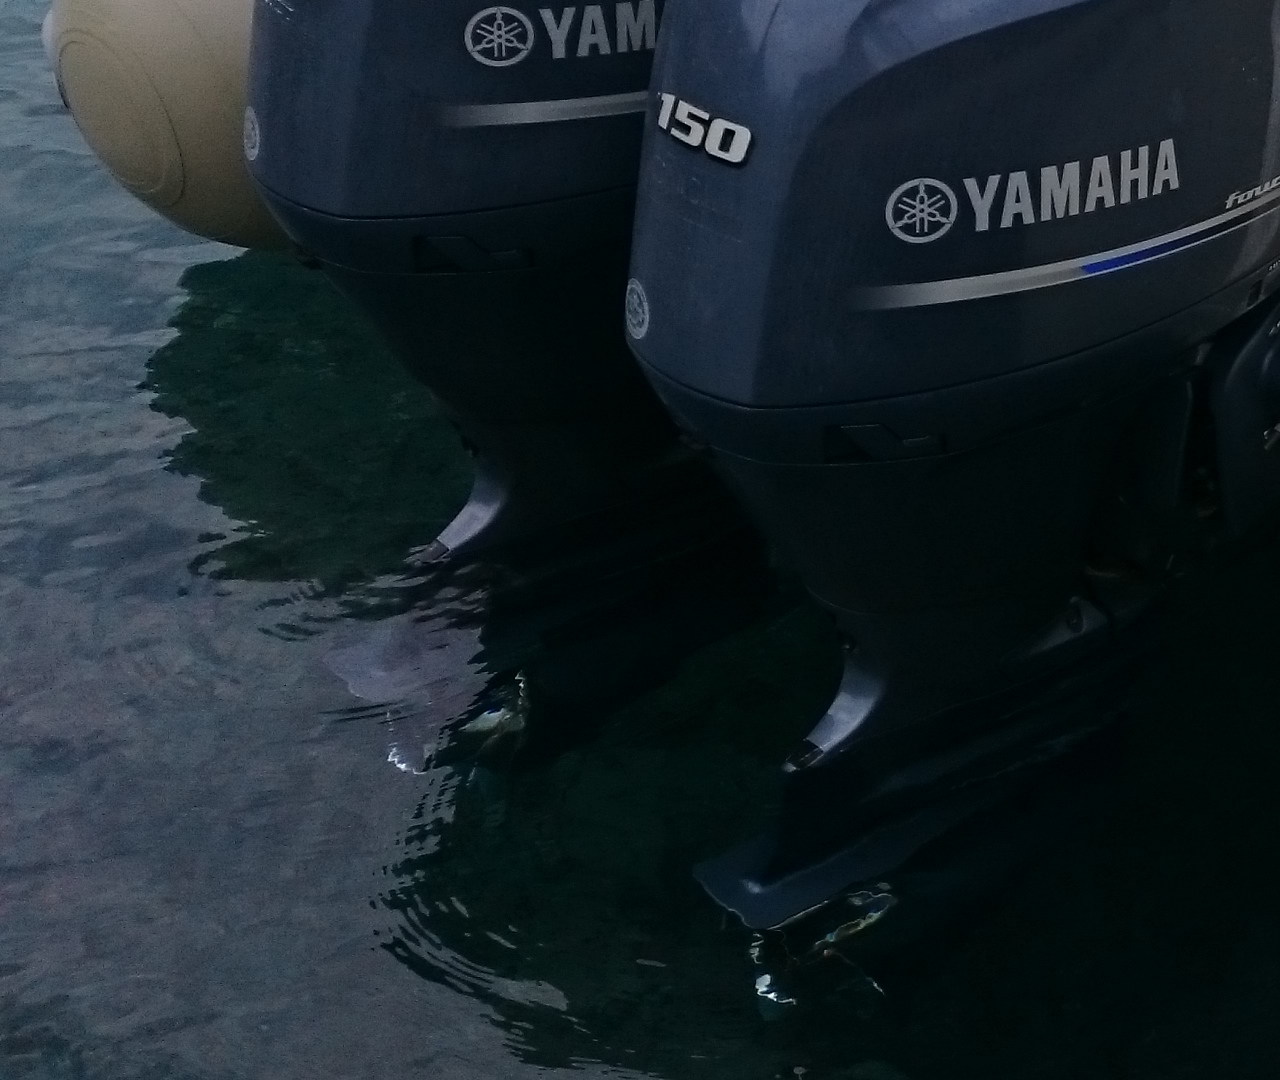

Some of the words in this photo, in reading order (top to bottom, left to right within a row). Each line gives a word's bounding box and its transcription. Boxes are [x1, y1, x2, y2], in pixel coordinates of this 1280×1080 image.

[538, 0, 656, 60] YAM
[657, 92, 752, 163] 150
[962, 138, 1180, 233] YAMAHA
